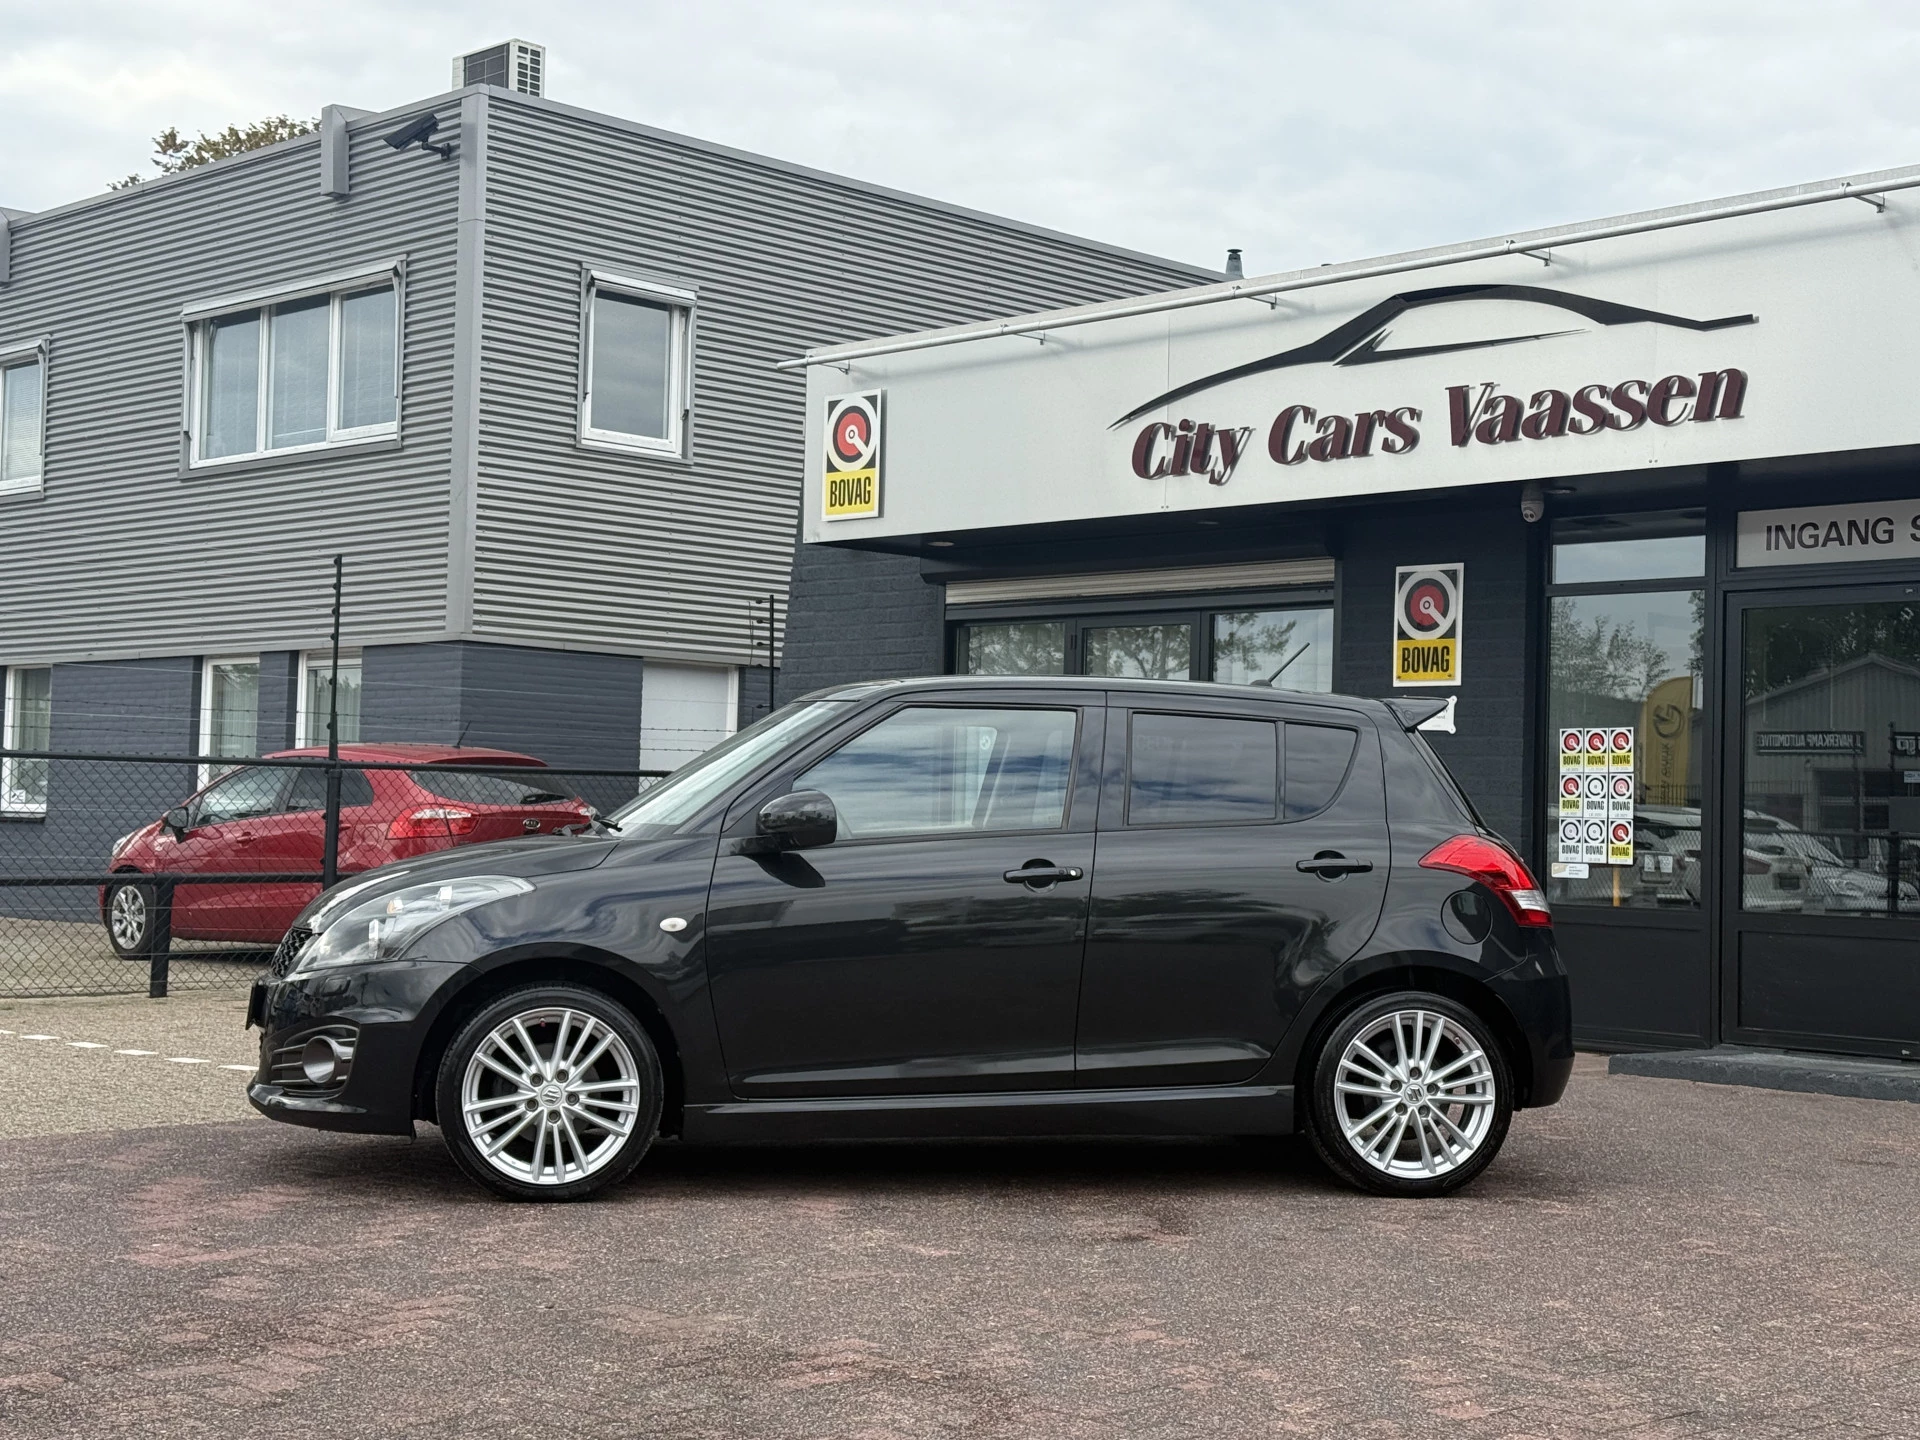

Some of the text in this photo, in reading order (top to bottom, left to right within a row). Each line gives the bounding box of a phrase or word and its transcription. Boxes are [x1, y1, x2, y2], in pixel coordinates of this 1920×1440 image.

[1131, 367, 1748, 486] City Cars Vaassen
[829, 476, 872, 508] BOVAG
[1765, 516, 1895, 551] INGANG
[1401, 645, 1450, 674] BOVAG
[1563, 755, 1581, 765] BOVAG
[1587, 755, 1605, 765] BOVAG
[1612, 754, 1630, 765] BOVAG
[1562, 799, 1580, 809] BOVAG
[1586, 800, 1605, 810] BOVAG
[1612, 801, 1630, 811] BOVAG
[1561, 845, 1580, 854] BOVAG
[1585, 845, 1604, 855] BOVAG
[1611, 846, 1630, 856] BOVAG
